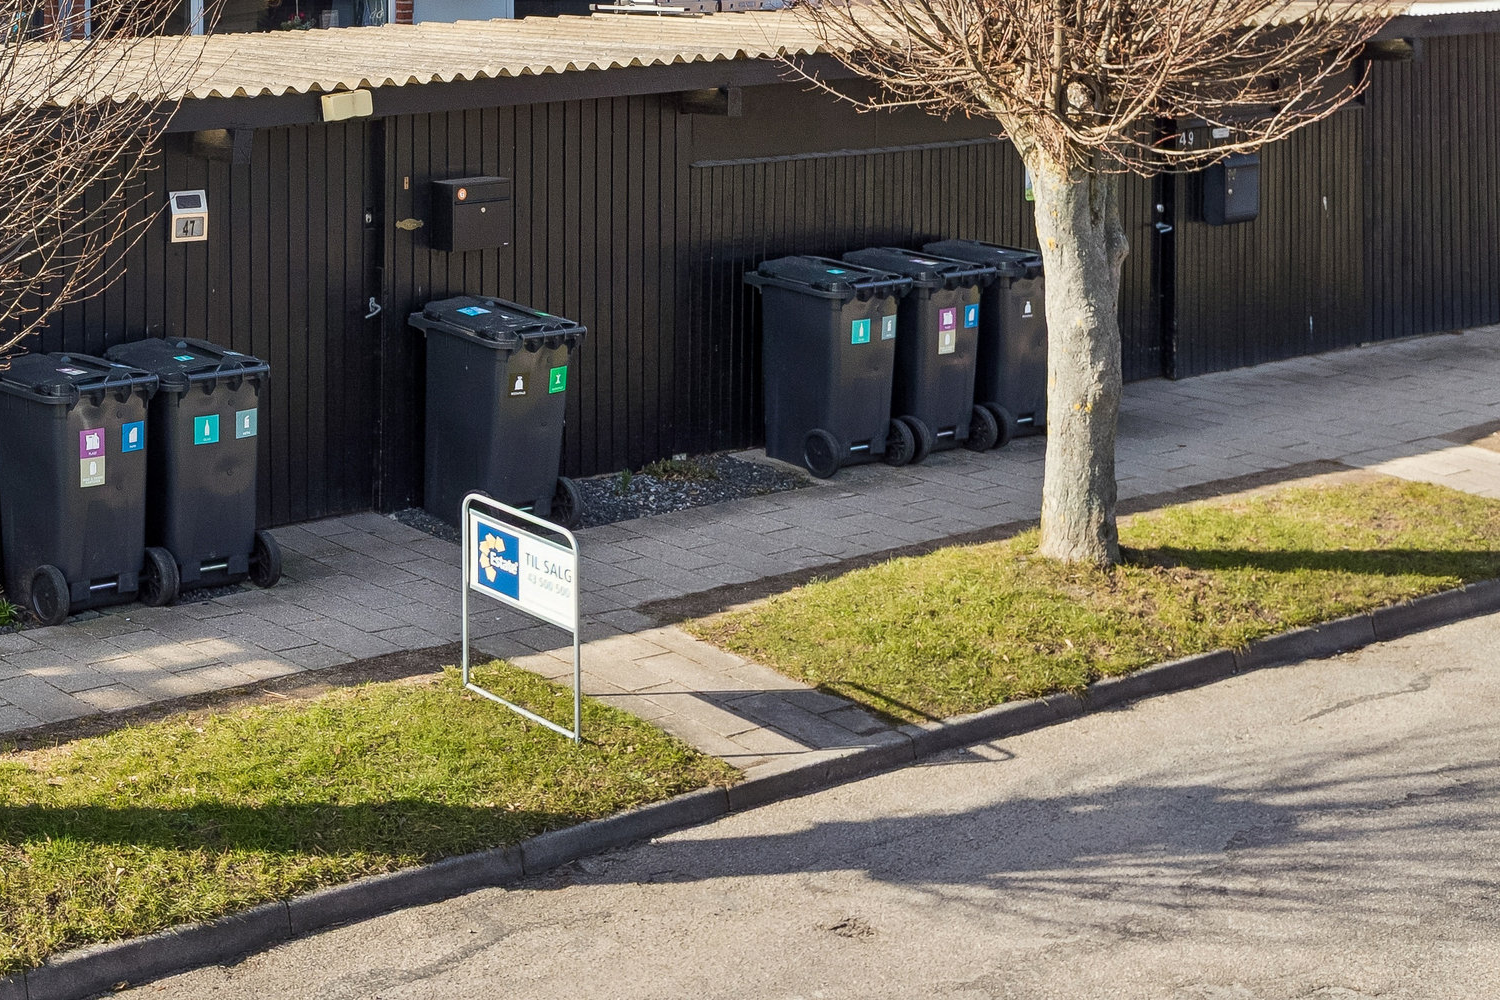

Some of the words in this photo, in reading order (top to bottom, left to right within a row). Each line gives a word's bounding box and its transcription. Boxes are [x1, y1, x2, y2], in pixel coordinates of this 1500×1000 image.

[1179, 131, 1194, 145] 49
[182, 220, 195, 236] 47
[490, 551, 518, 575] Estate
[525, 552, 541, 571] TIL
[543, 560, 572, 583] SALG
